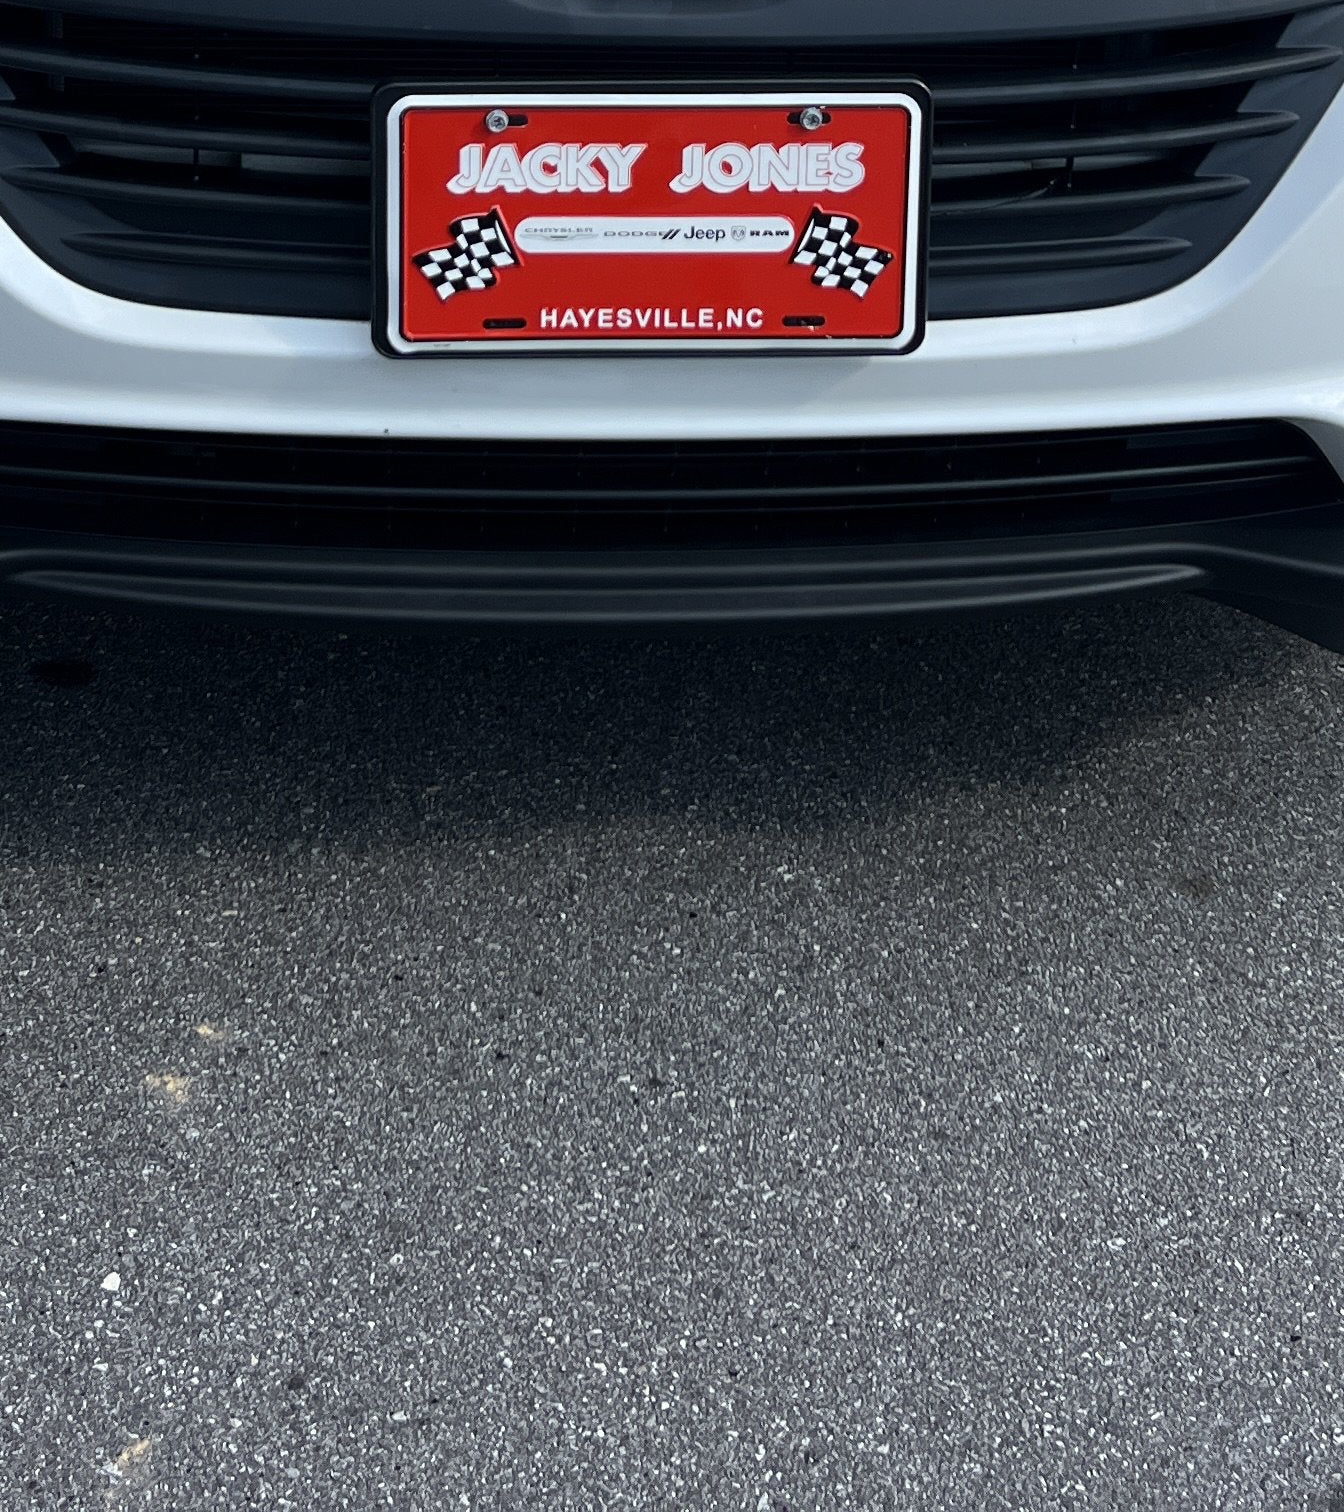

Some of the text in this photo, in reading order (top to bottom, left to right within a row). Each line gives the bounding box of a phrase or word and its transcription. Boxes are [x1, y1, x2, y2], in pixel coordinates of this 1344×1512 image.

[446, 142, 866, 194] JACKY JONES
[683, 226, 726, 242] Jeep
